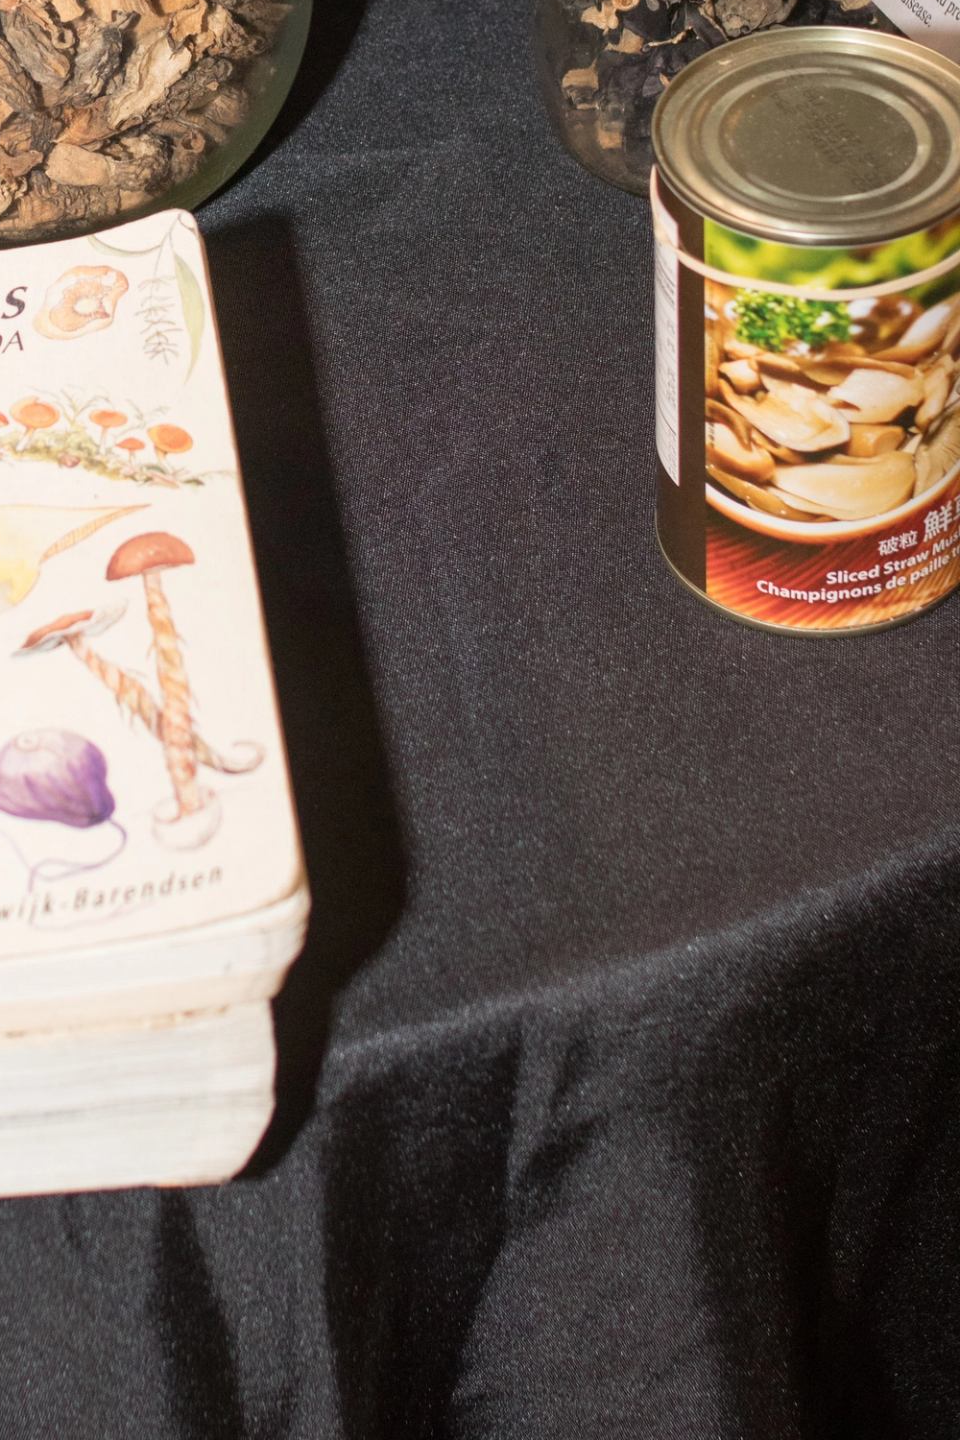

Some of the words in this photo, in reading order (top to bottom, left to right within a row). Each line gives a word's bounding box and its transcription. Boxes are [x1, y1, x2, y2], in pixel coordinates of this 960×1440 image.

[756, 580, 881, 604] Champignons
[885, 575, 906, 590] de
[910, 555, 950, 585] paille
[826, 566, 880, 585] Sliced
[884, 551, 929, 575] Straw
